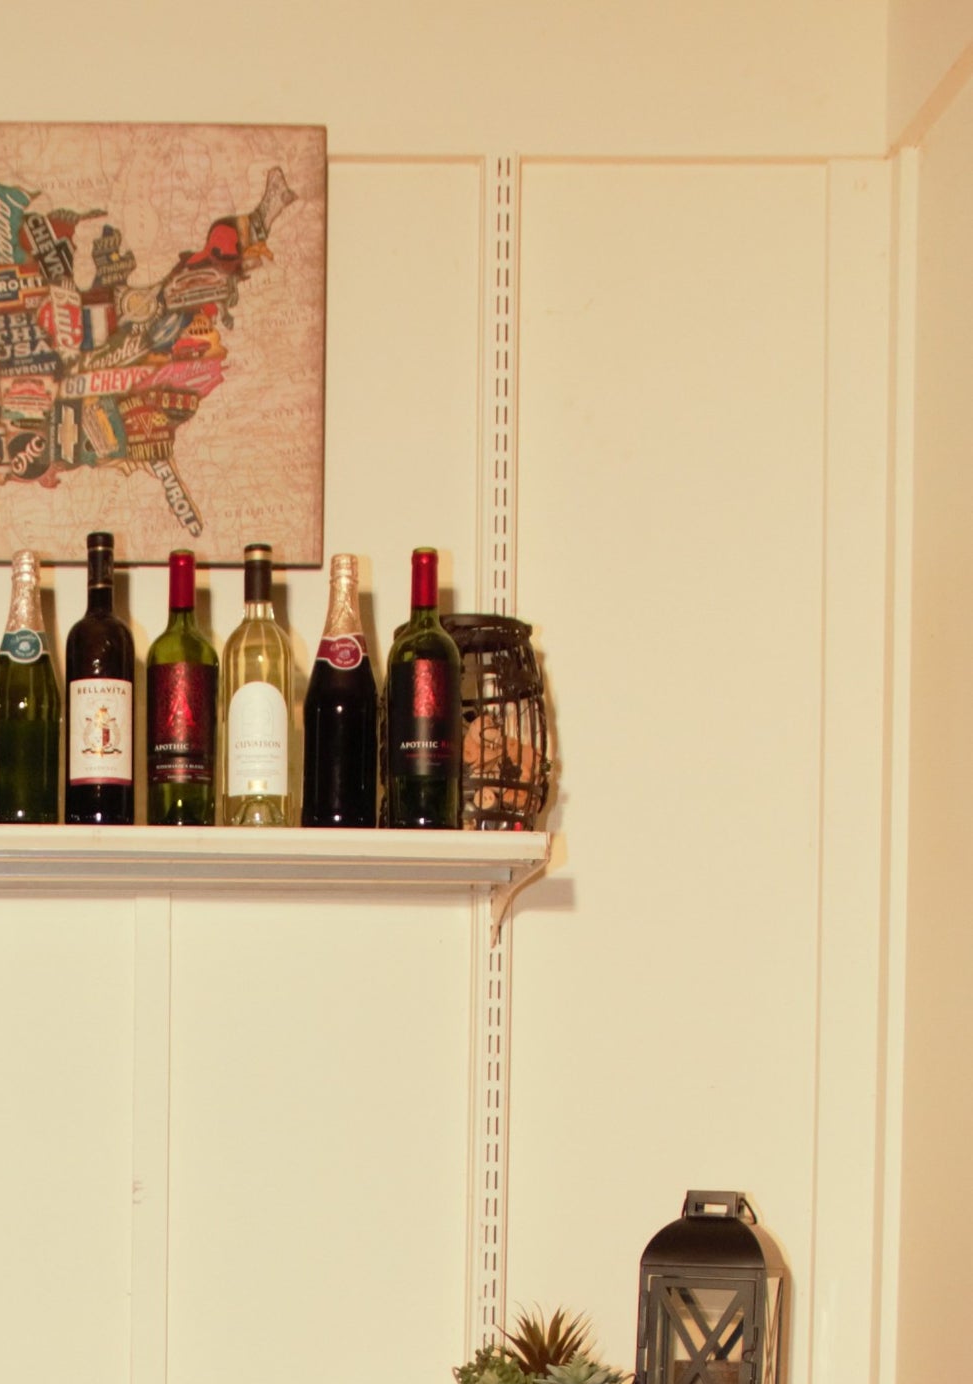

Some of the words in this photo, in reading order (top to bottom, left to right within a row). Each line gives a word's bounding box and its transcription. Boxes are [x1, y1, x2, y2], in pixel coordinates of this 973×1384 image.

[11, 435, 46, 475] GMC
[77, 687, 127, 695] BELLAVITA
[155, 742, 190, 752] APOTHIC
[400, 740, 438, 750] APOTHIC
